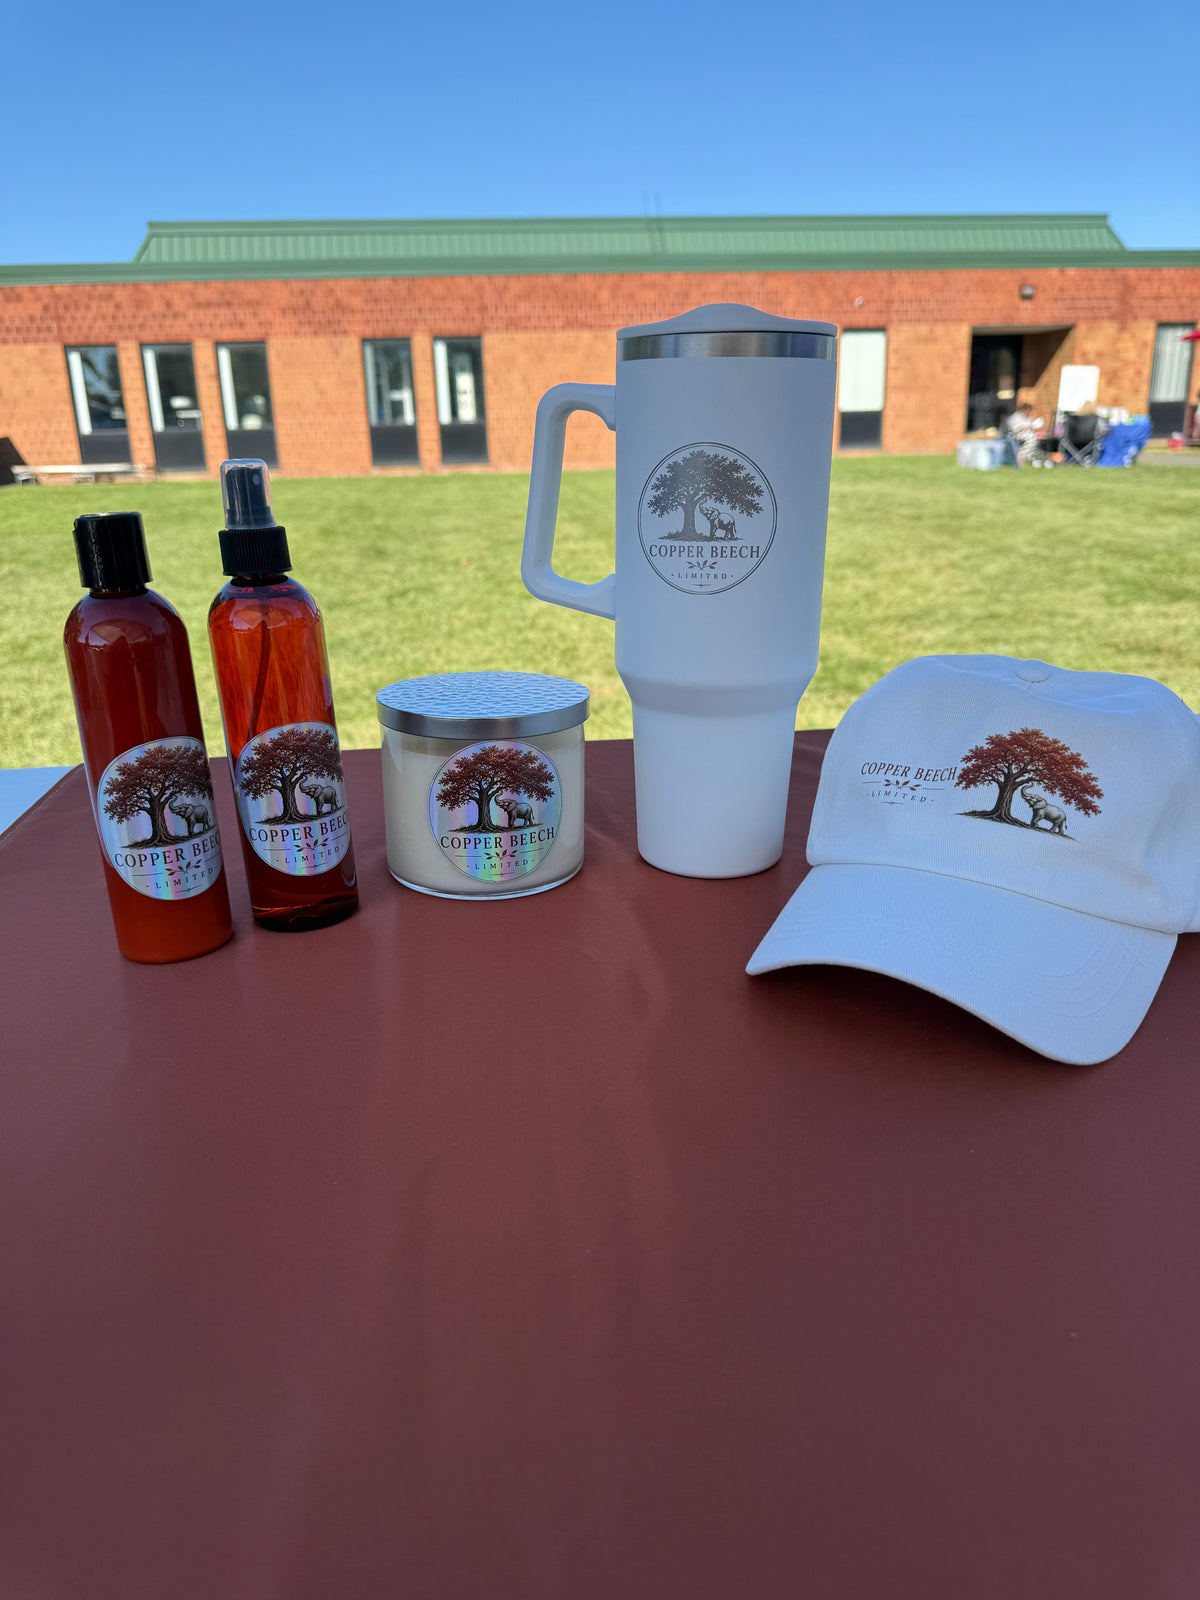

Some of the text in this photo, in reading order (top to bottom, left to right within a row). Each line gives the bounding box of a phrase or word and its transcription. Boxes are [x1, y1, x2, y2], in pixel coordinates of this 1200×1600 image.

[649, 544, 760, 559] COPPER BEECH
[678, 572, 727, 580] LIMITED
[861, 762, 958, 782] COPPER BEECH
[871, 790, 926, 802] LIMITED
[249, 811, 348, 842] COPPER BEEC
[440, 827, 555, 849] COPPER BEECH
[114, 830, 220, 868] COPPER BEEC
[285, 847, 340, 864] LIMITED
[475, 859, 529, 870] LIMITED
[156, 867, 214, 889] LIMITED
